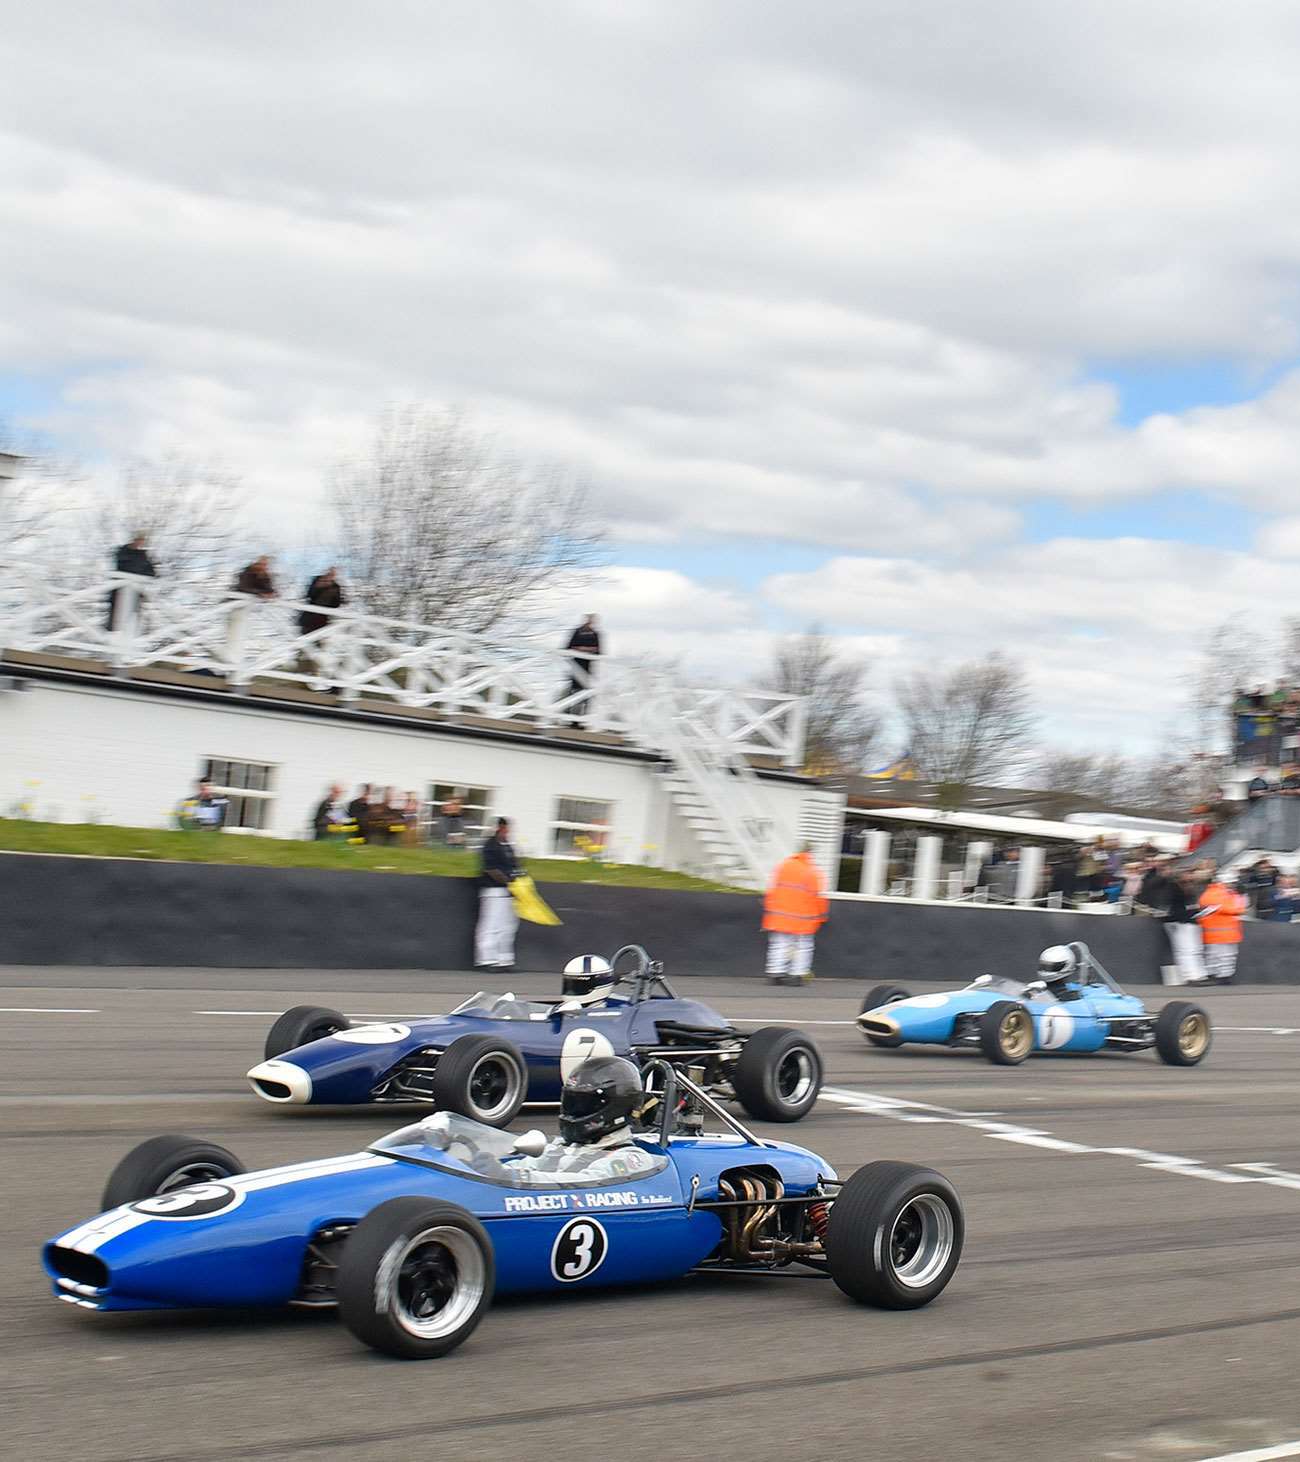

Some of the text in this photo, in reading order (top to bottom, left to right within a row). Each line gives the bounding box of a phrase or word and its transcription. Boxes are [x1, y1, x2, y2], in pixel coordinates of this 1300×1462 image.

[578, 1036, 596, 1063] 7
[134, 1185, 230, 1213] 3
[504, 1194, 569, 1212] PROJECT
[585, 1191, 639, 1208] RACING
[563, 1224, 595, 1277] 3
